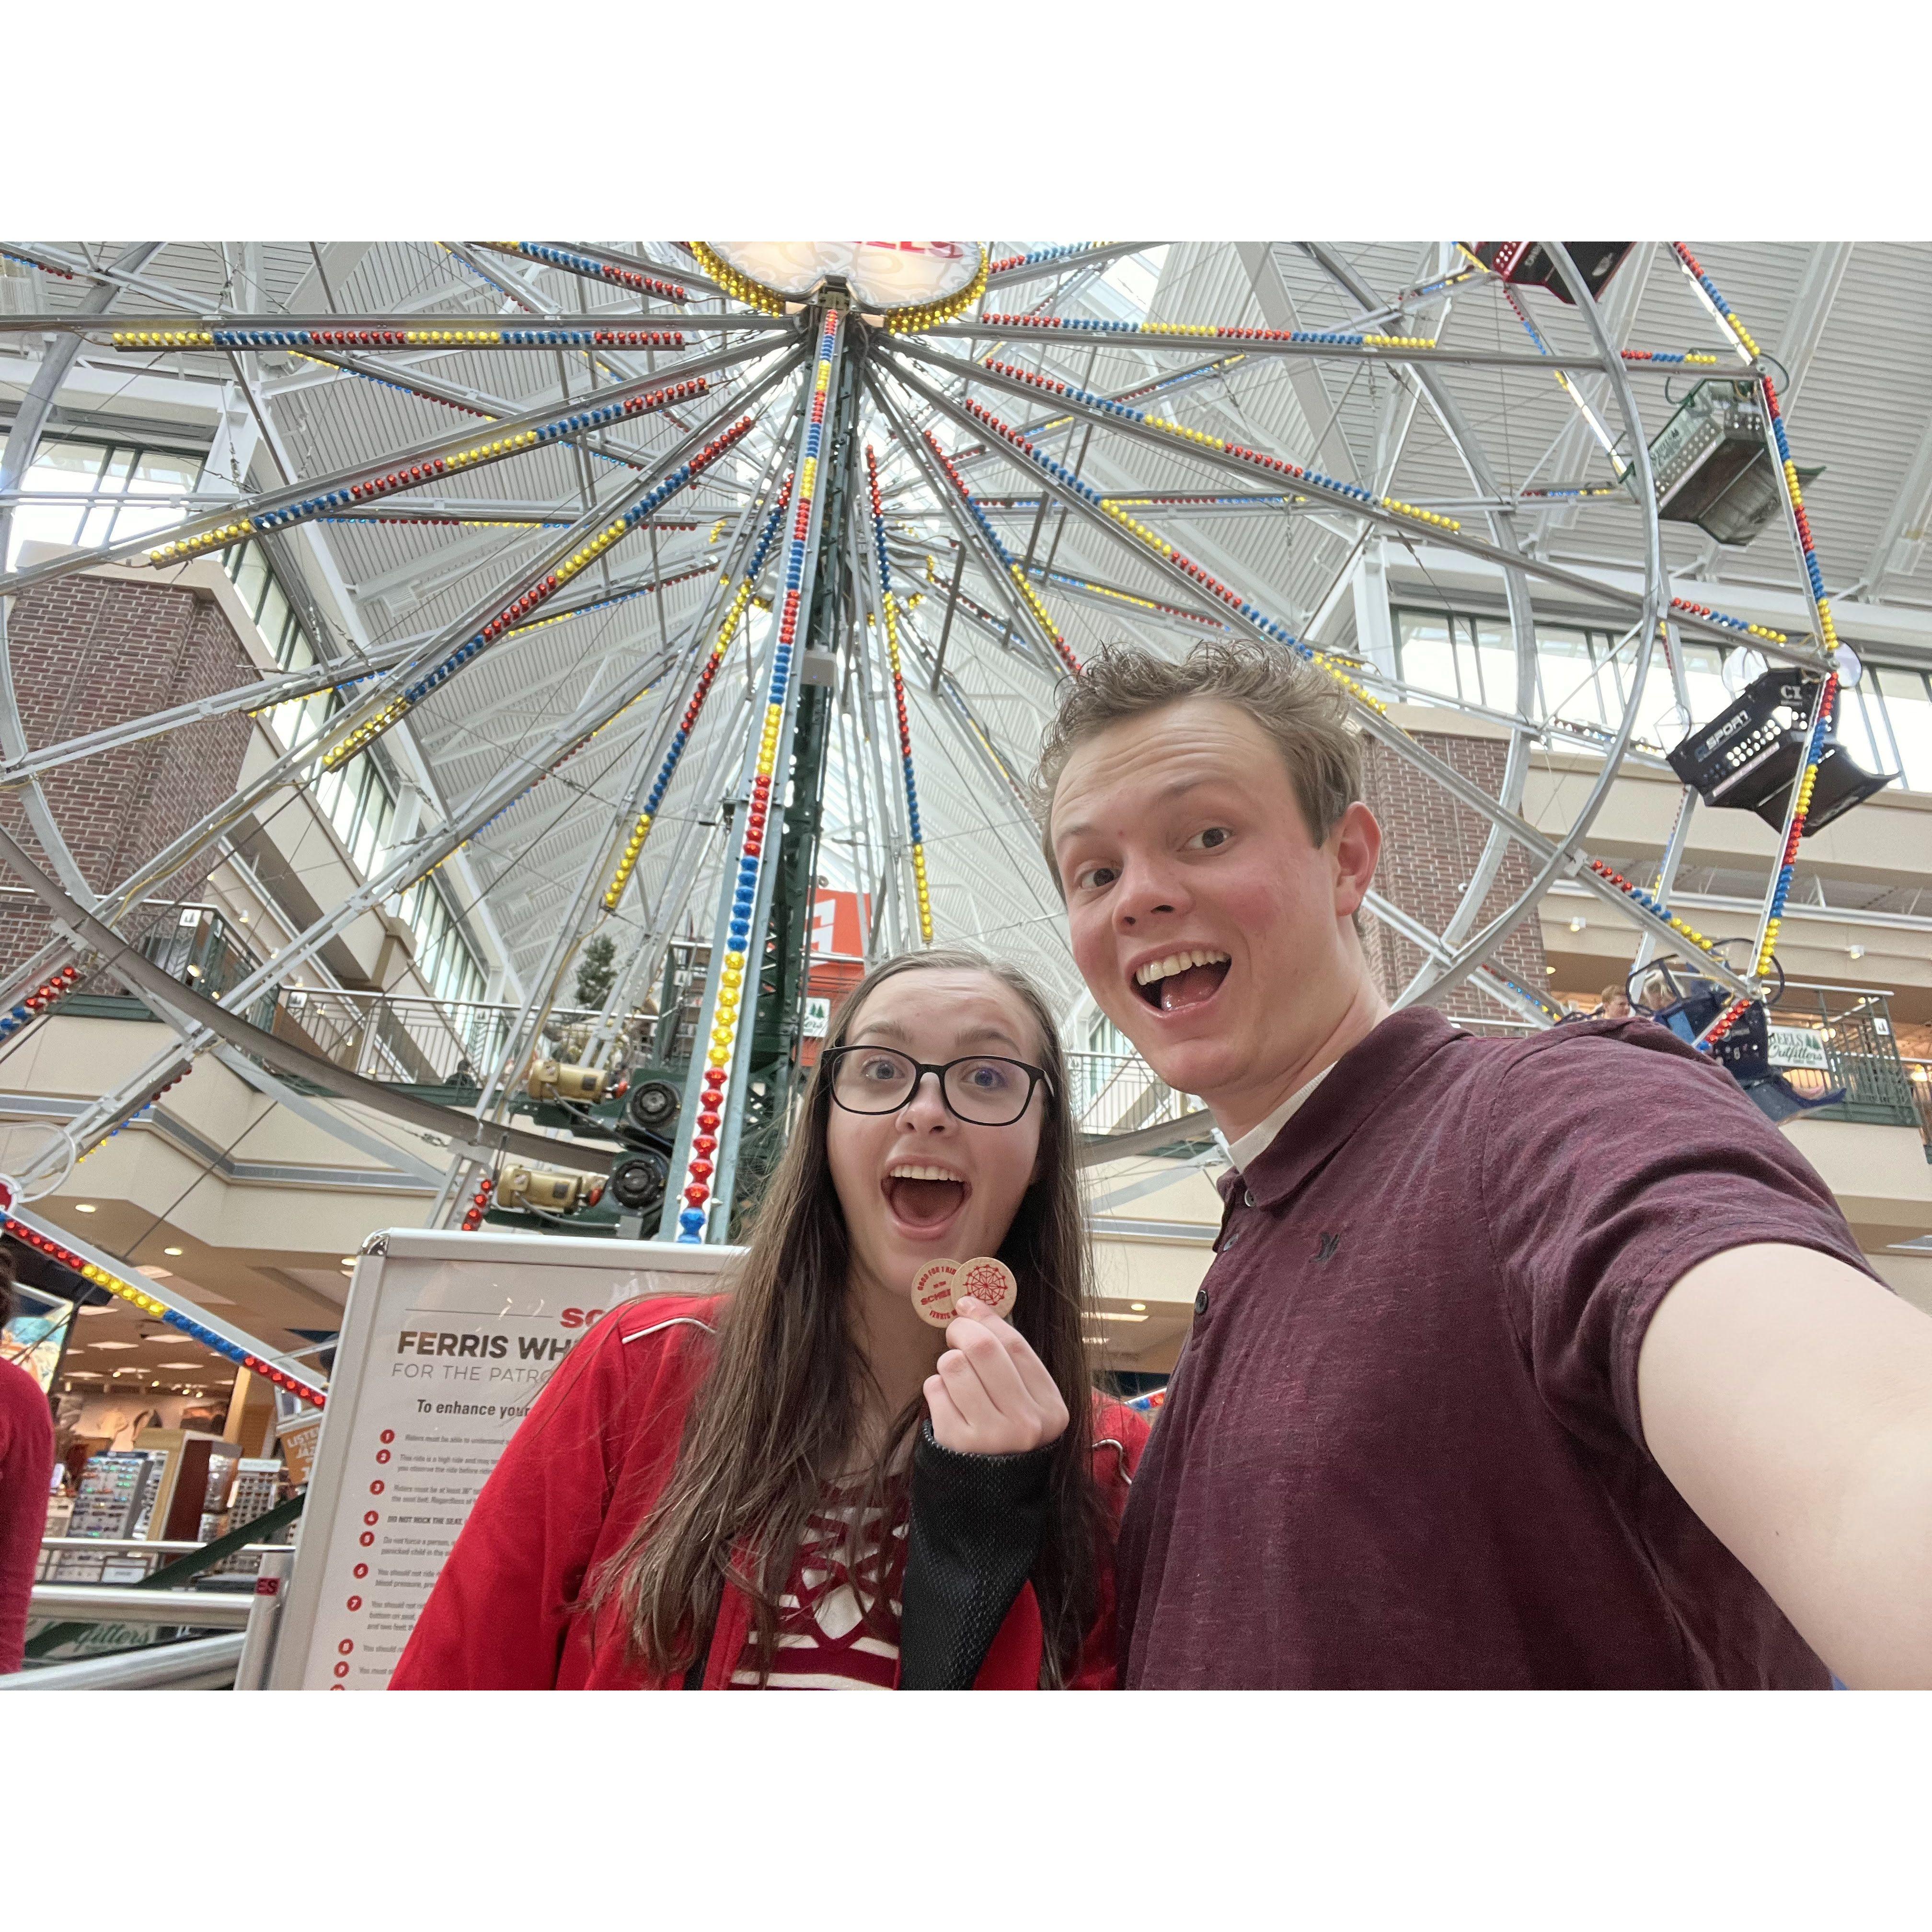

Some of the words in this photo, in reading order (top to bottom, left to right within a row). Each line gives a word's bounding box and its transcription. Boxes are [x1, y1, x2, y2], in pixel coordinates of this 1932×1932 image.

[397, 1331, 508, 1358] FERRIS
[392, 1363, 434, 1379] FOR
[442, 1365, 481, 1381] THE
[417, 1398, 431, 1413] To
[436, 1401, 495, 1416] enhance
